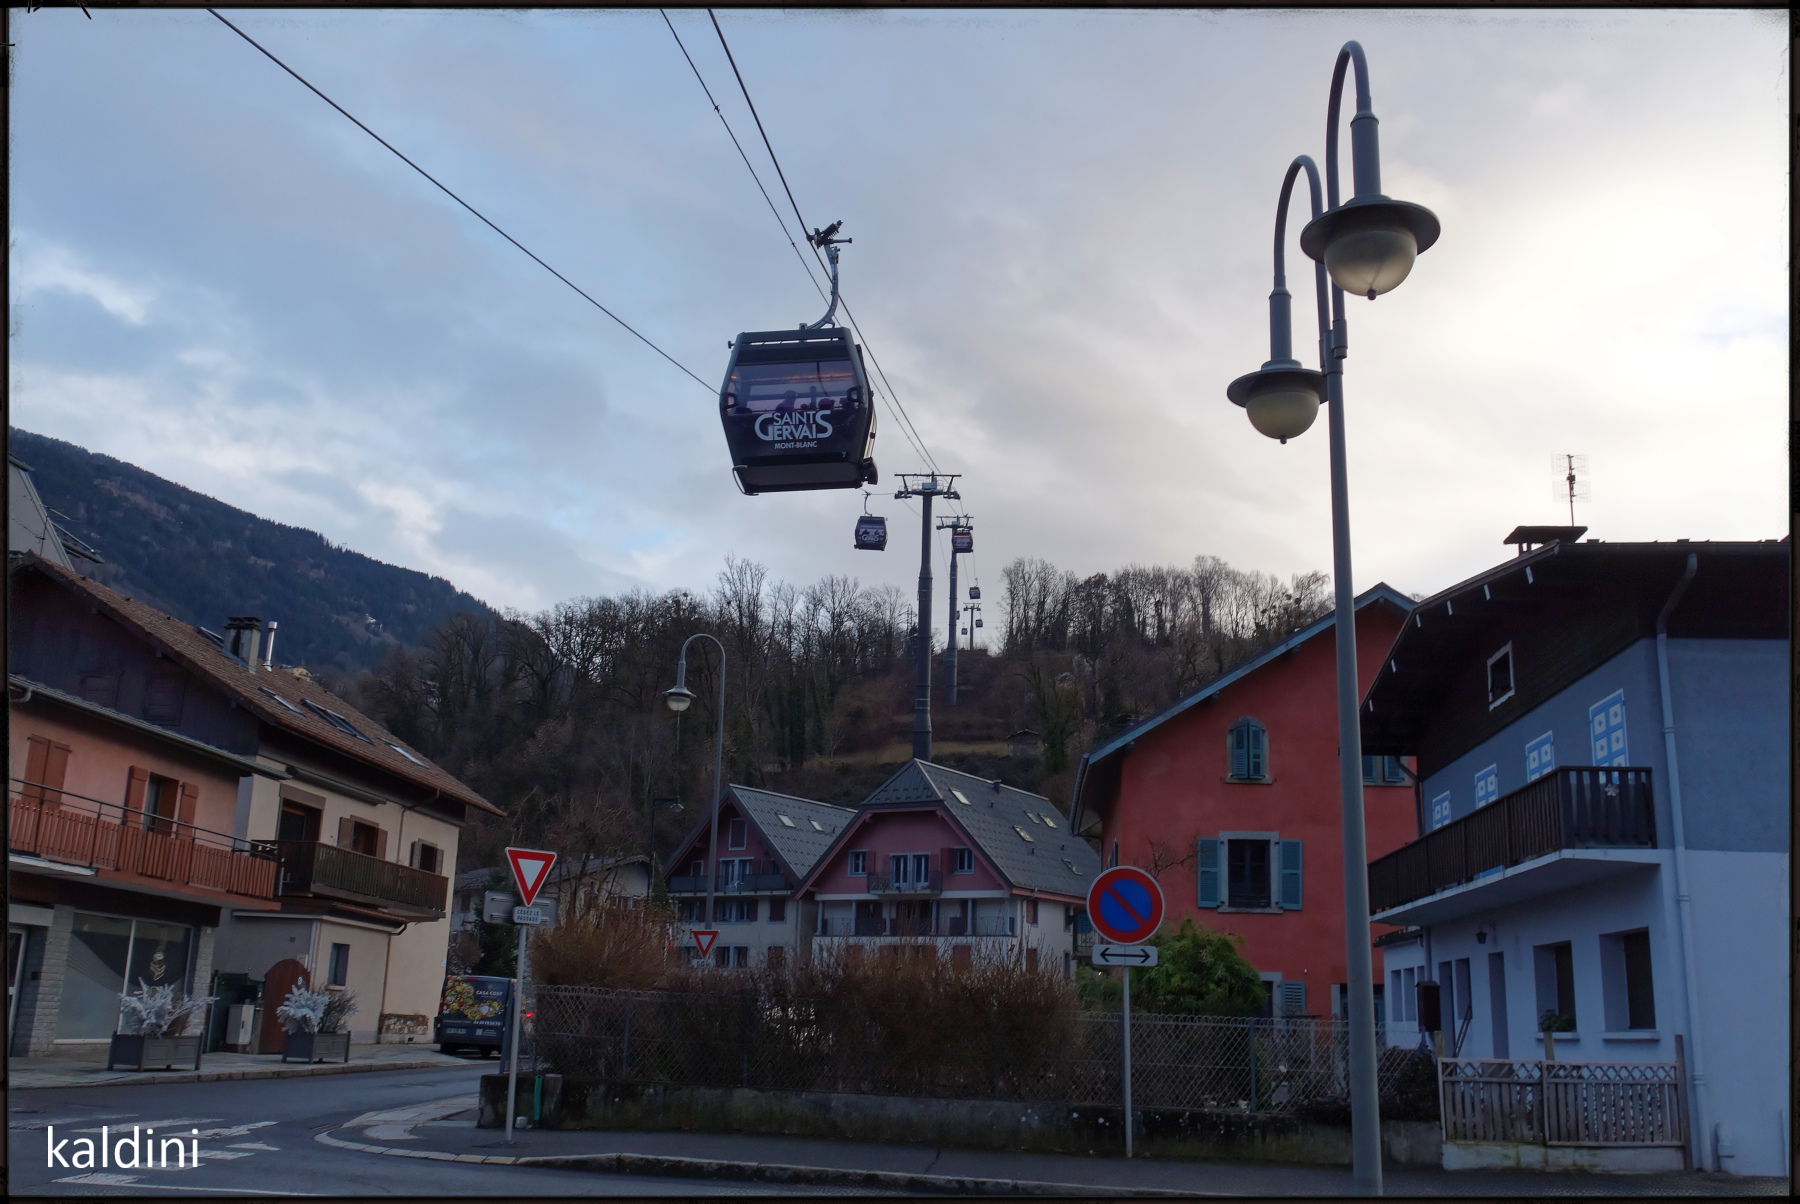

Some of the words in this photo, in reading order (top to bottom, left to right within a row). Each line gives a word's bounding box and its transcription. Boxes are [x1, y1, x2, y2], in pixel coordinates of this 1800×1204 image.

[773, 411, 816, 425] SAINT
[754, 410, 833, 441] GERVAIS
[774, 441, 818, 450] MONT-BLANC
[517, 908, 533, 916] CÉDEZ
